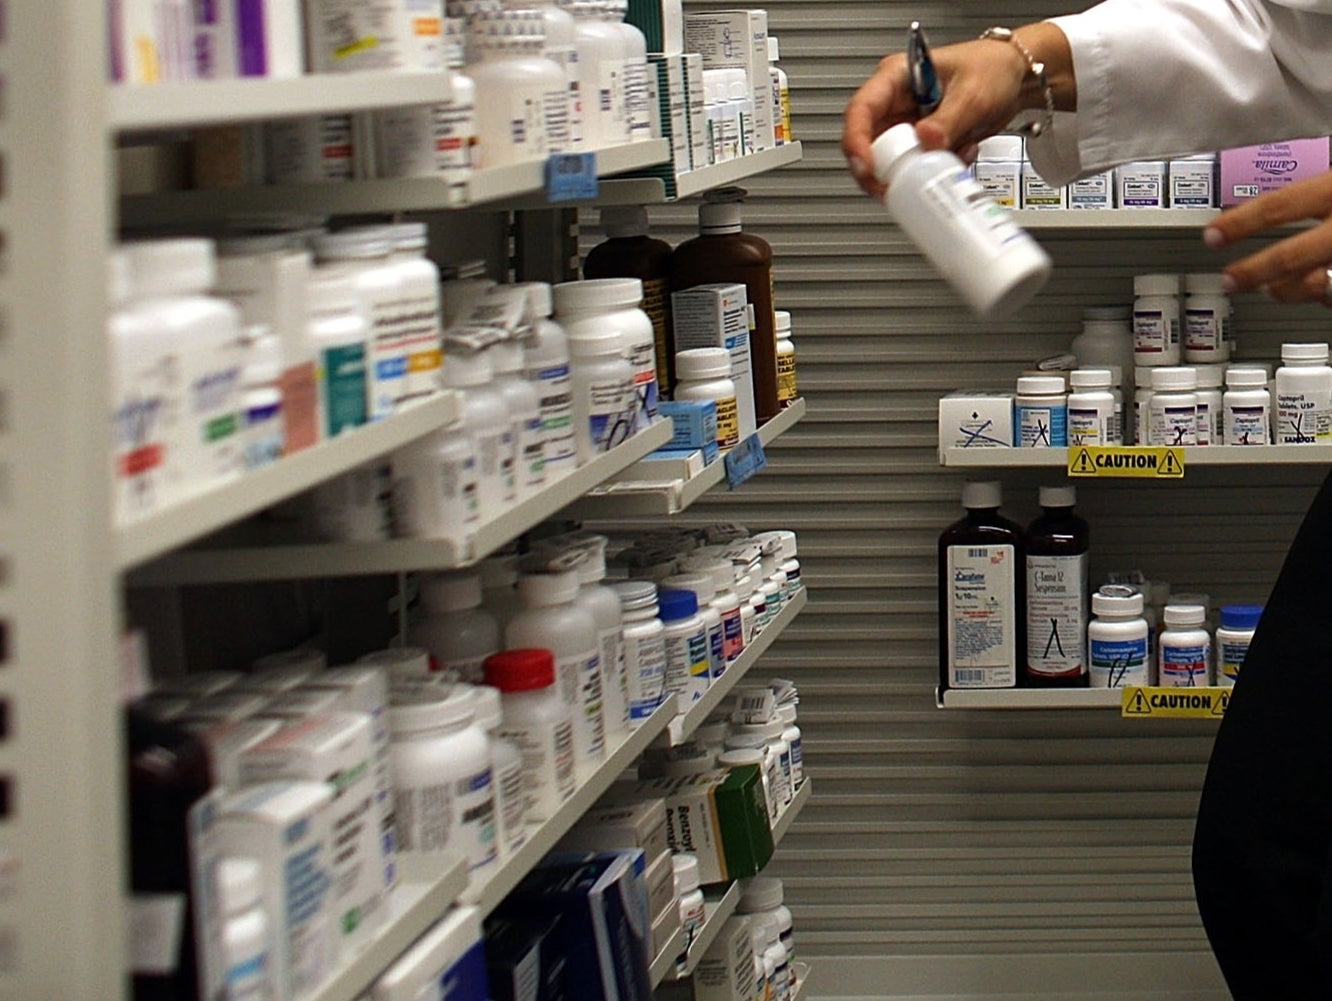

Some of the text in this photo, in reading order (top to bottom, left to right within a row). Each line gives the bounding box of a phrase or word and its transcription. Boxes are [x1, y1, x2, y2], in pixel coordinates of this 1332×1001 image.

[1254, 160, 1298, 174] Camila
[1300, 402, 1315, 410] USP
[1288, 410, 1299, 418] mg
[1096, 454, 1158, 468] CAUTION
[1151, 694, 1212, 709] CAUTION
[678, 805, 697, 853] Benzoyl
